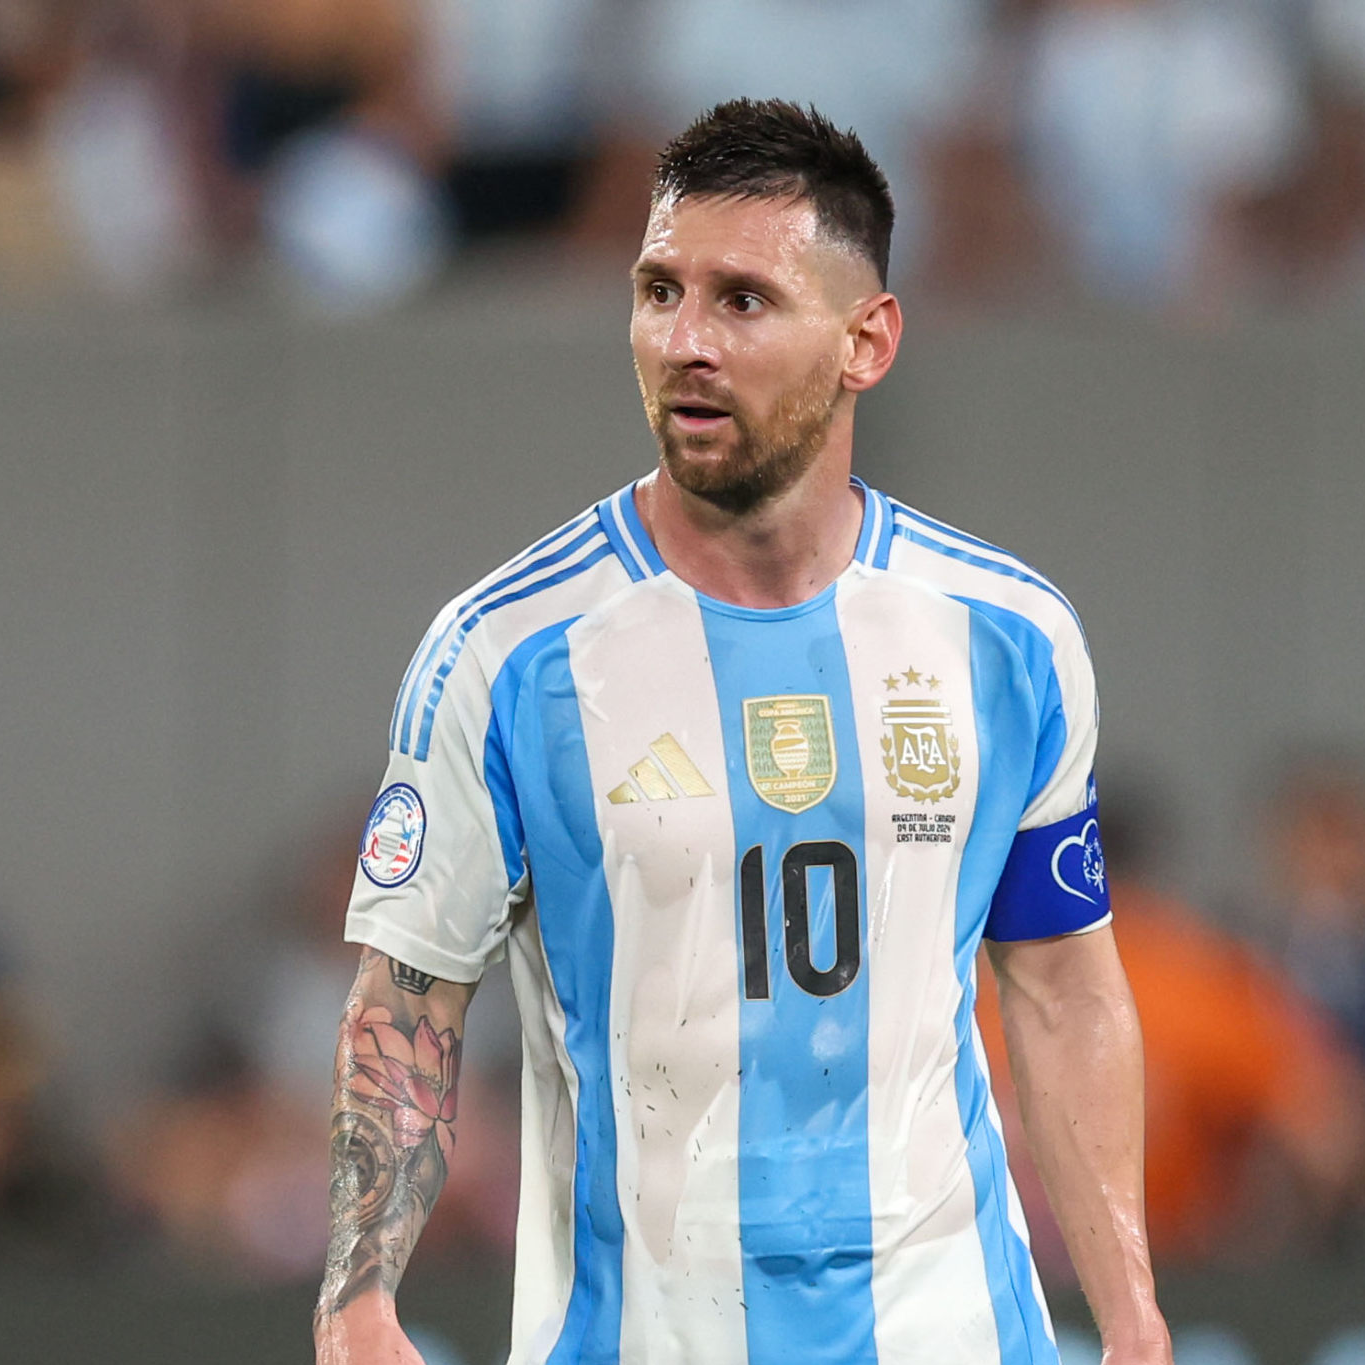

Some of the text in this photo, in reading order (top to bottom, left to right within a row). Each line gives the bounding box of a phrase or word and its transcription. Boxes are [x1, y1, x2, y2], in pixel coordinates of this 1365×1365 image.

[900, 725, 947, 774] AFA
[892, 814, 927, 822] ARGENTINA
[909, 824, 917, 832] DE
[919, 824, 935, 832] JULIO
[936, 824, 951, 832] 2024
[740, 839, 861, 1001] 10
